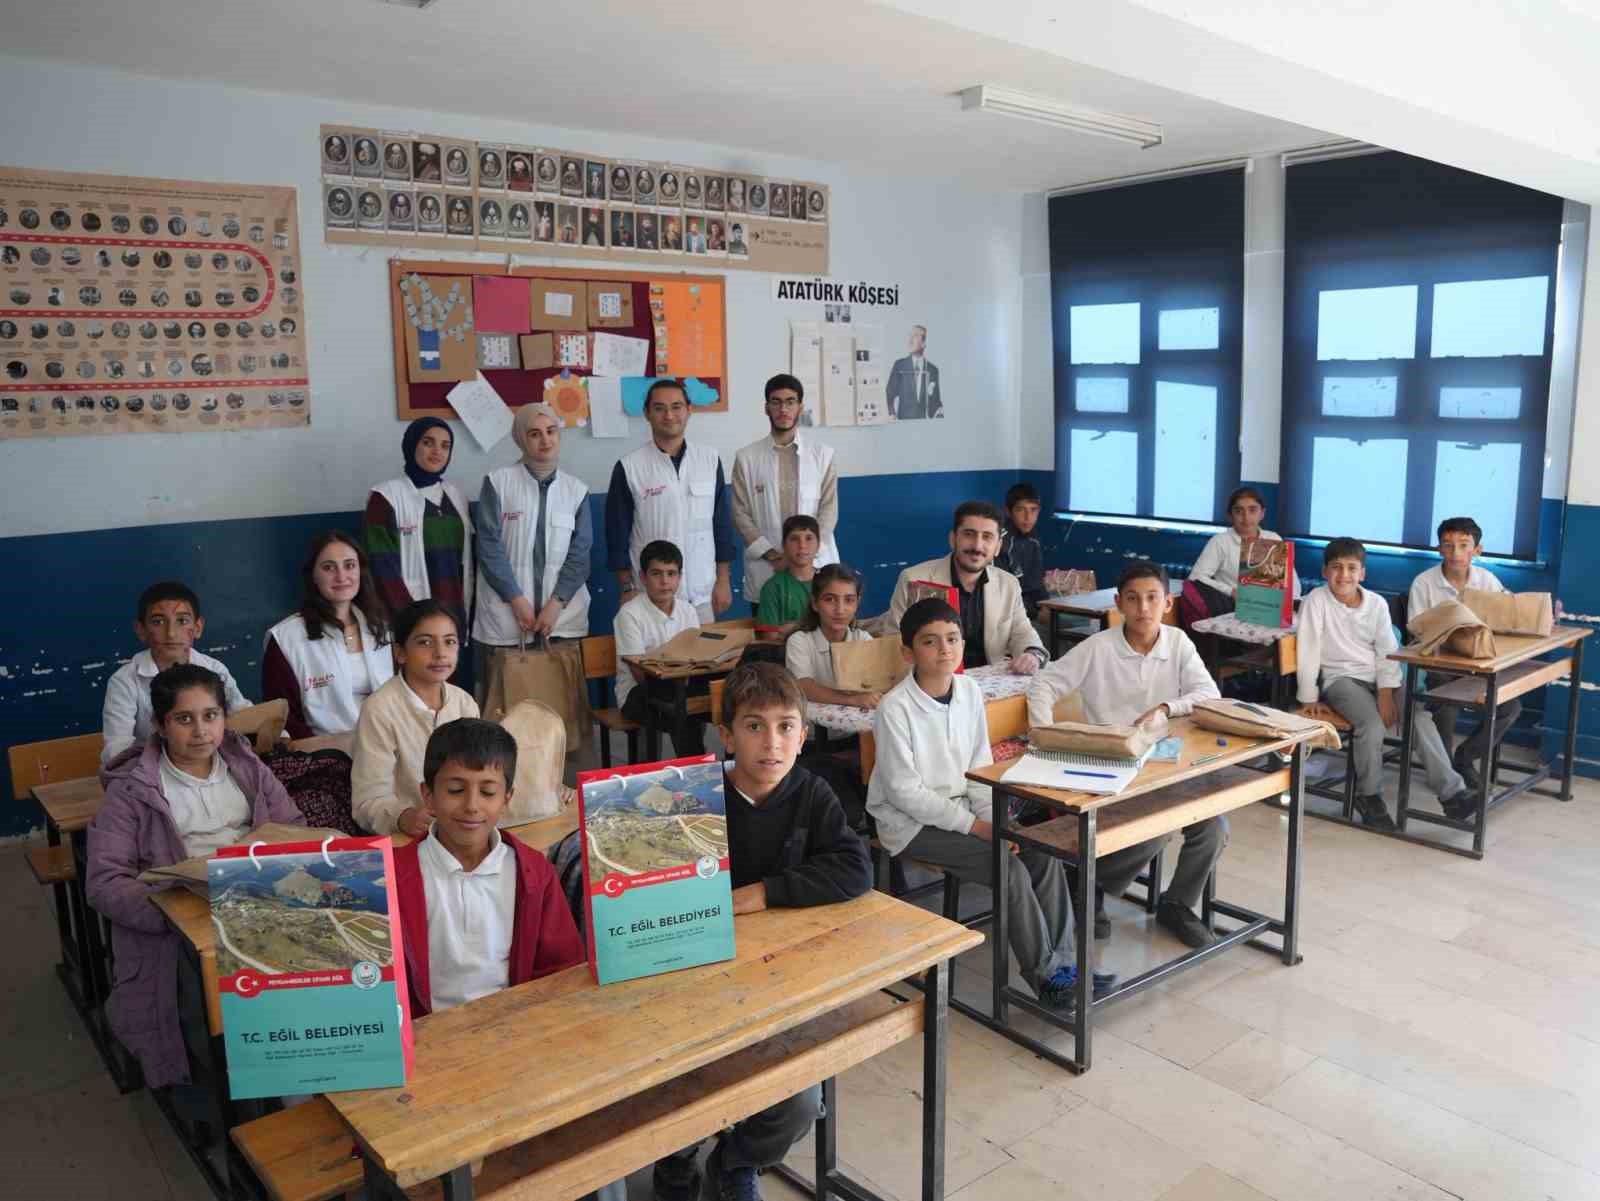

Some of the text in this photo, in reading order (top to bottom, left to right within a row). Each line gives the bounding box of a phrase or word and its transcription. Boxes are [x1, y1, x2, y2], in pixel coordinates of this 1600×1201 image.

[777, 278, 899, 306] ATATÜRK KÖŞESİ
[608, 927, 627, 937] T.C.
[631, 919, 655, 933] EĞİL
[659, 905, 721, 928] BELEDİYESİ
[241, 1021, 385, 1045] T.C. EĞİL BELEDİYESİ
